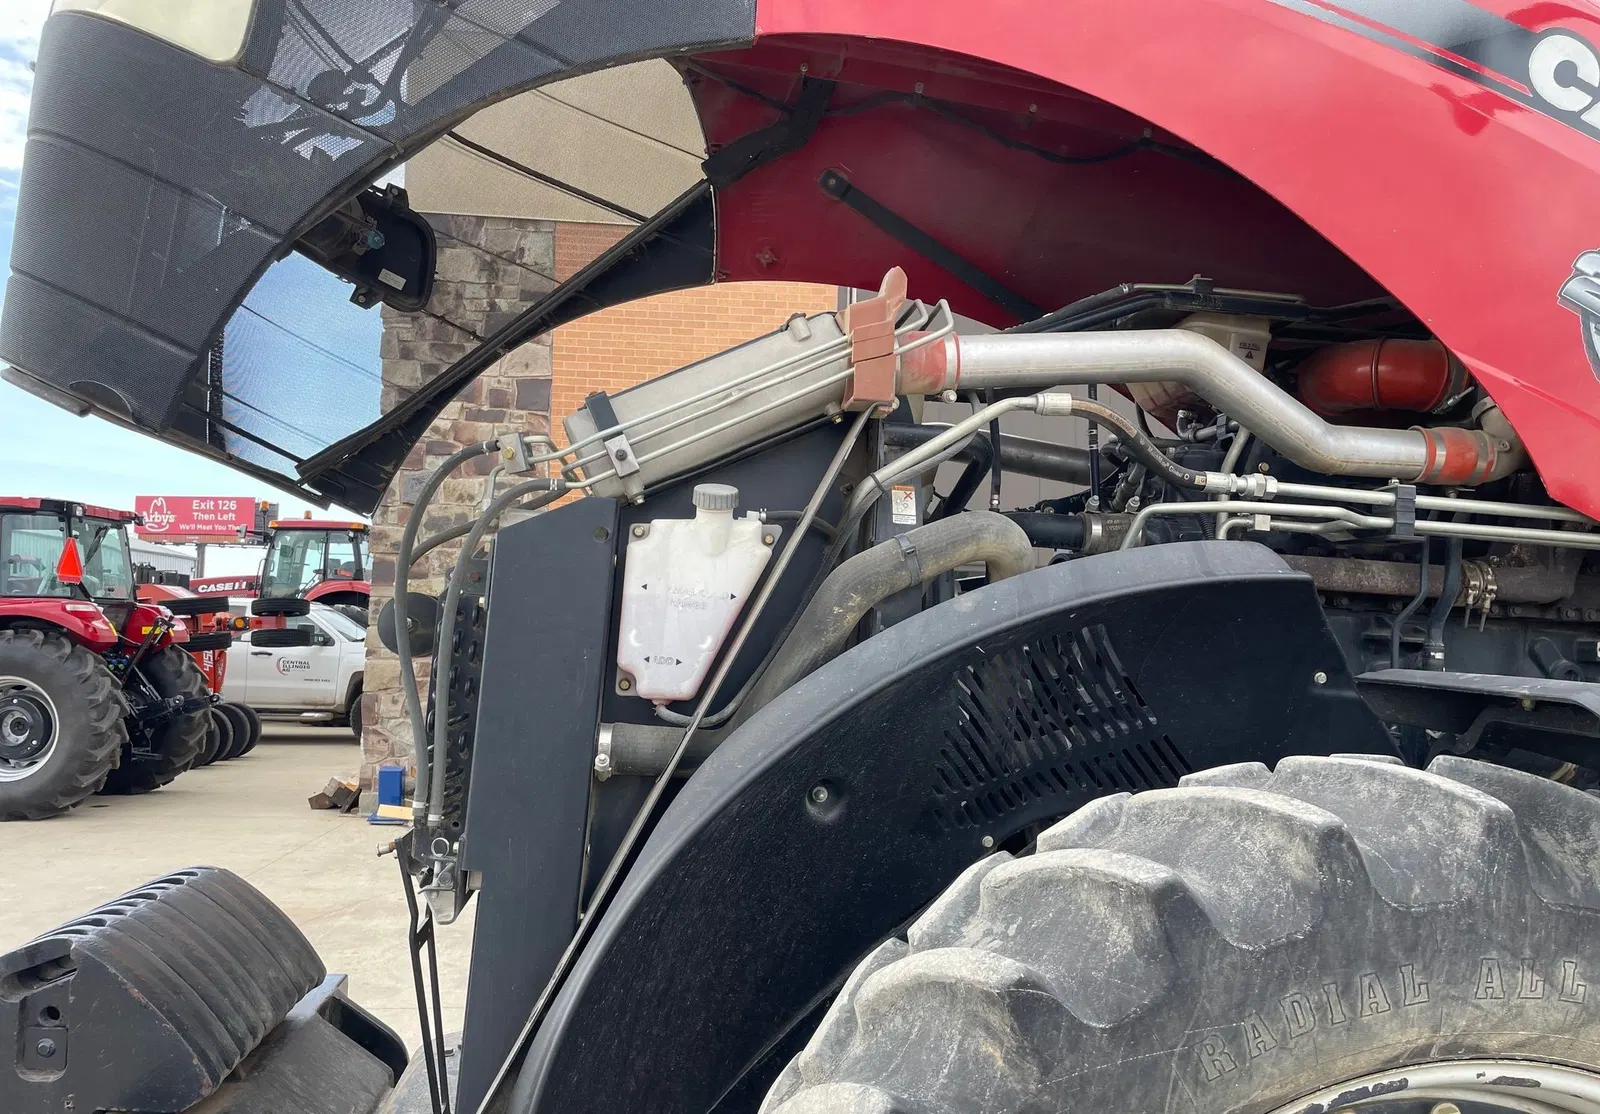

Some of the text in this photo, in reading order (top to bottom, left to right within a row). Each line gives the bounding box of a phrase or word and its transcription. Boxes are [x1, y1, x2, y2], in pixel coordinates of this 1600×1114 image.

[1528, 34, 1600, 130] C
[192, 499, 237, 510] Exit 126
[142, 510, 176, 526] Arby's
[192, 512, 236, 521] Then Left
[179, 523, 196, 531] We'll
[198, 582, 234, 593] CASE
[1192, 957, 1587, 1082] RADIAL ALL
